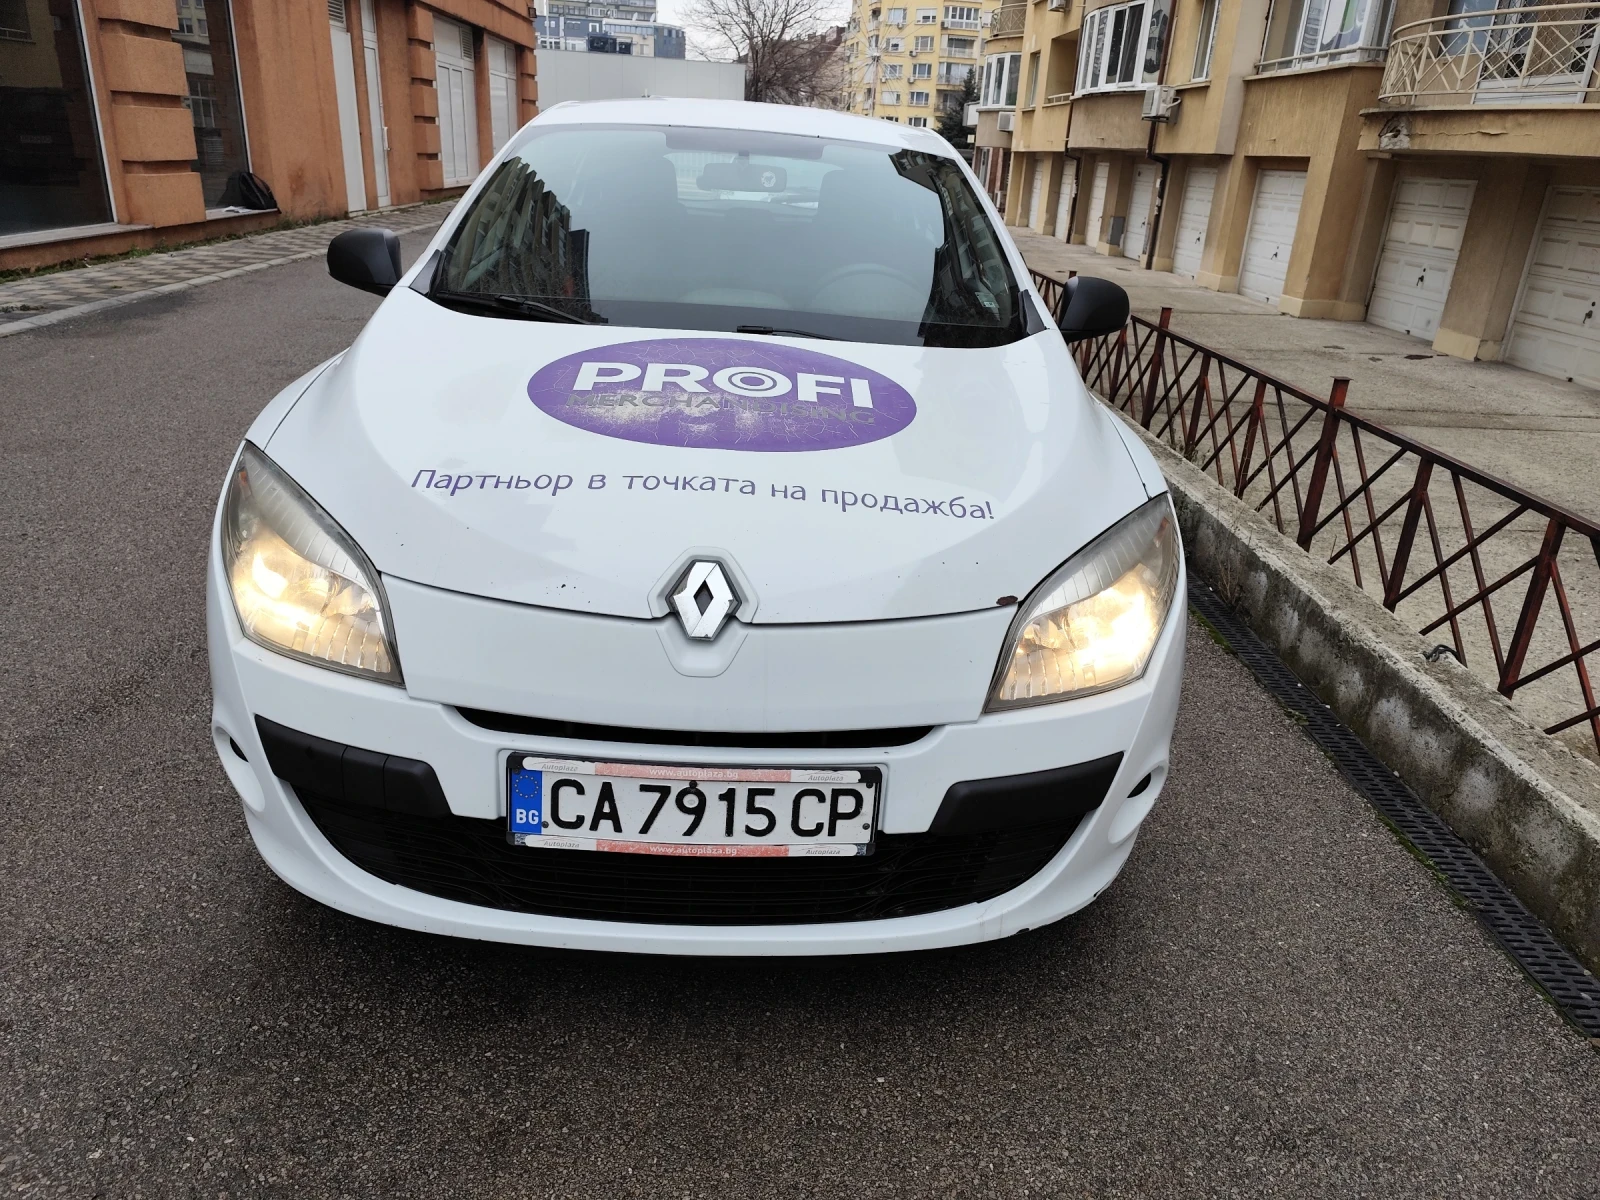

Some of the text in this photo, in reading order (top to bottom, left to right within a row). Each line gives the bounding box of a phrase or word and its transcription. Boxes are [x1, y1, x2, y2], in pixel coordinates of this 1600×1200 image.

[572, 362, 874, 409] PROFI
[566, 393, 876, 425] MERCHANDISING
[410, 469, 996, 521] Партньор в точката на продажба!
[649, 767, 739, 779] www.autoplaza.bg
[515, 808, 540, 825] BG
[638, 783, 776, 837] 7915
[649, 845, 738, 856] www.autoplaza.bg
[805, 848, 841, 856] Autoplaza
